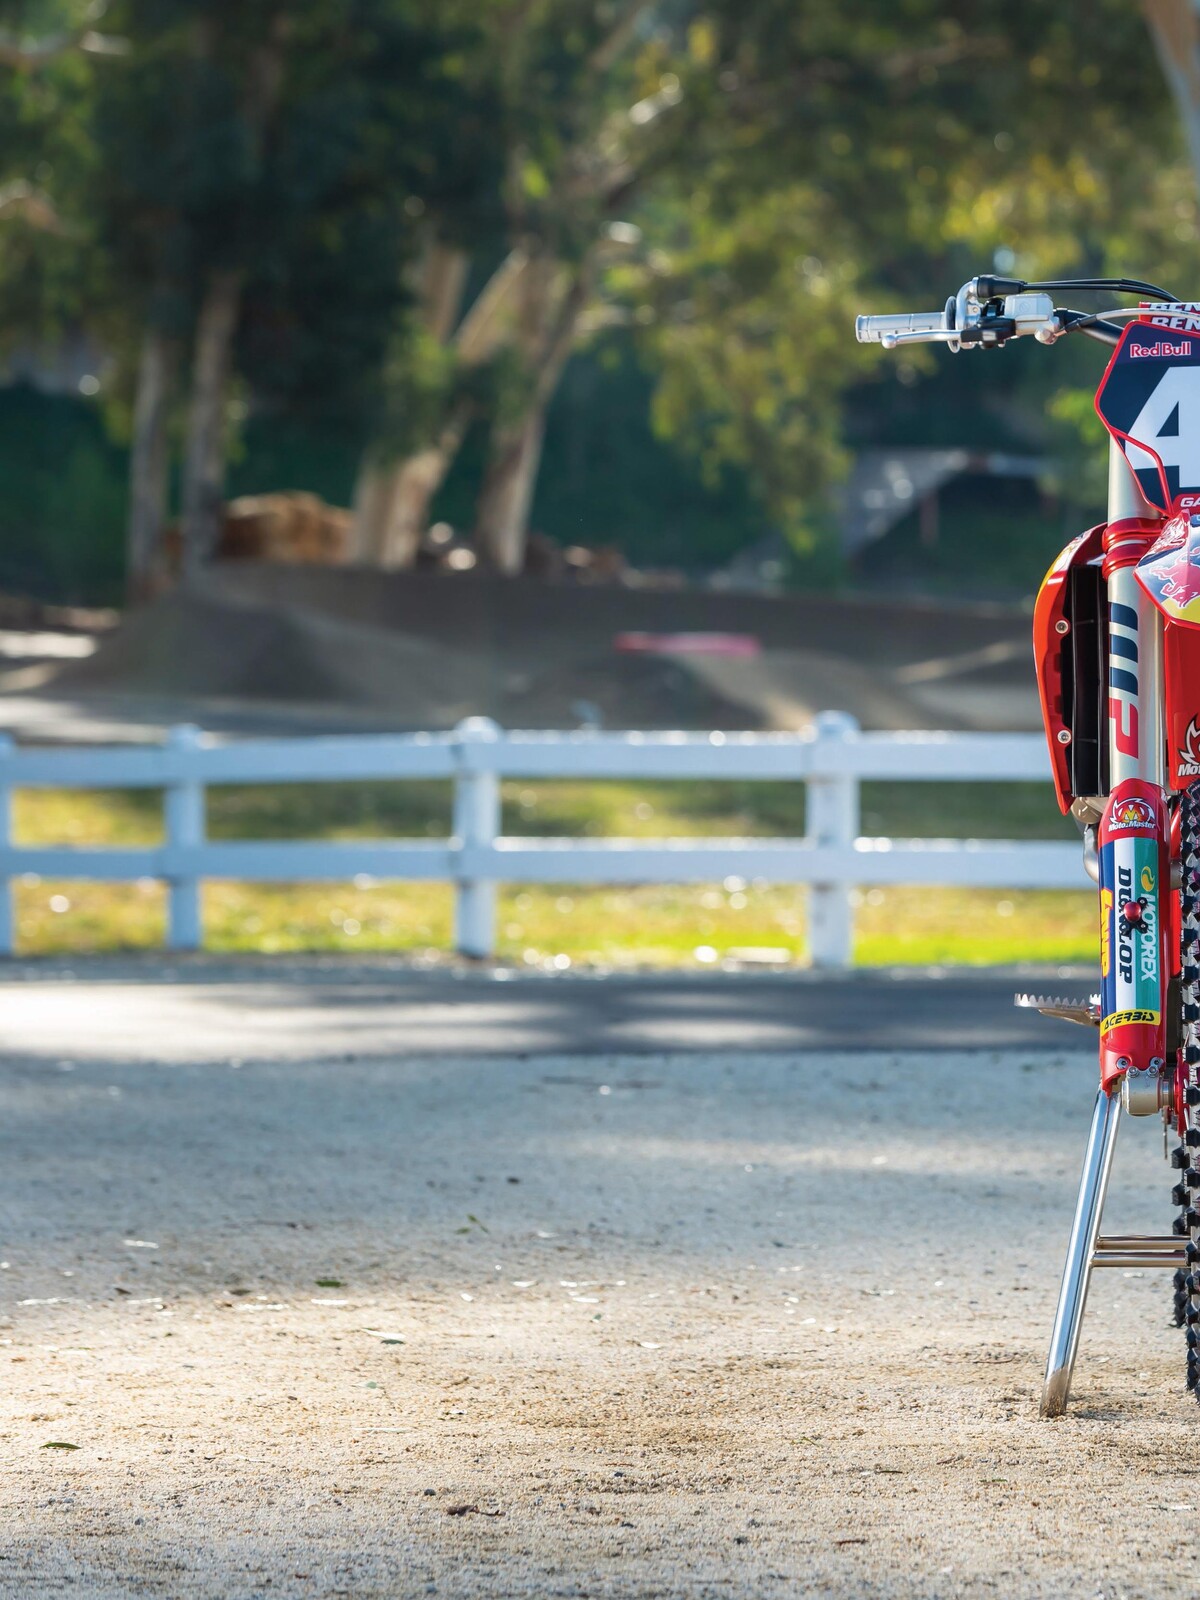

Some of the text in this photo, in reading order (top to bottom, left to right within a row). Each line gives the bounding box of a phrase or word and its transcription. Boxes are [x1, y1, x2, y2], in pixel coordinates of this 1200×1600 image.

[1130, 341, 1191, 358] Red Bull
[1118, 865, 1133, 985] DULOP
[1140, 893, 1157, 983] MOTOREX
